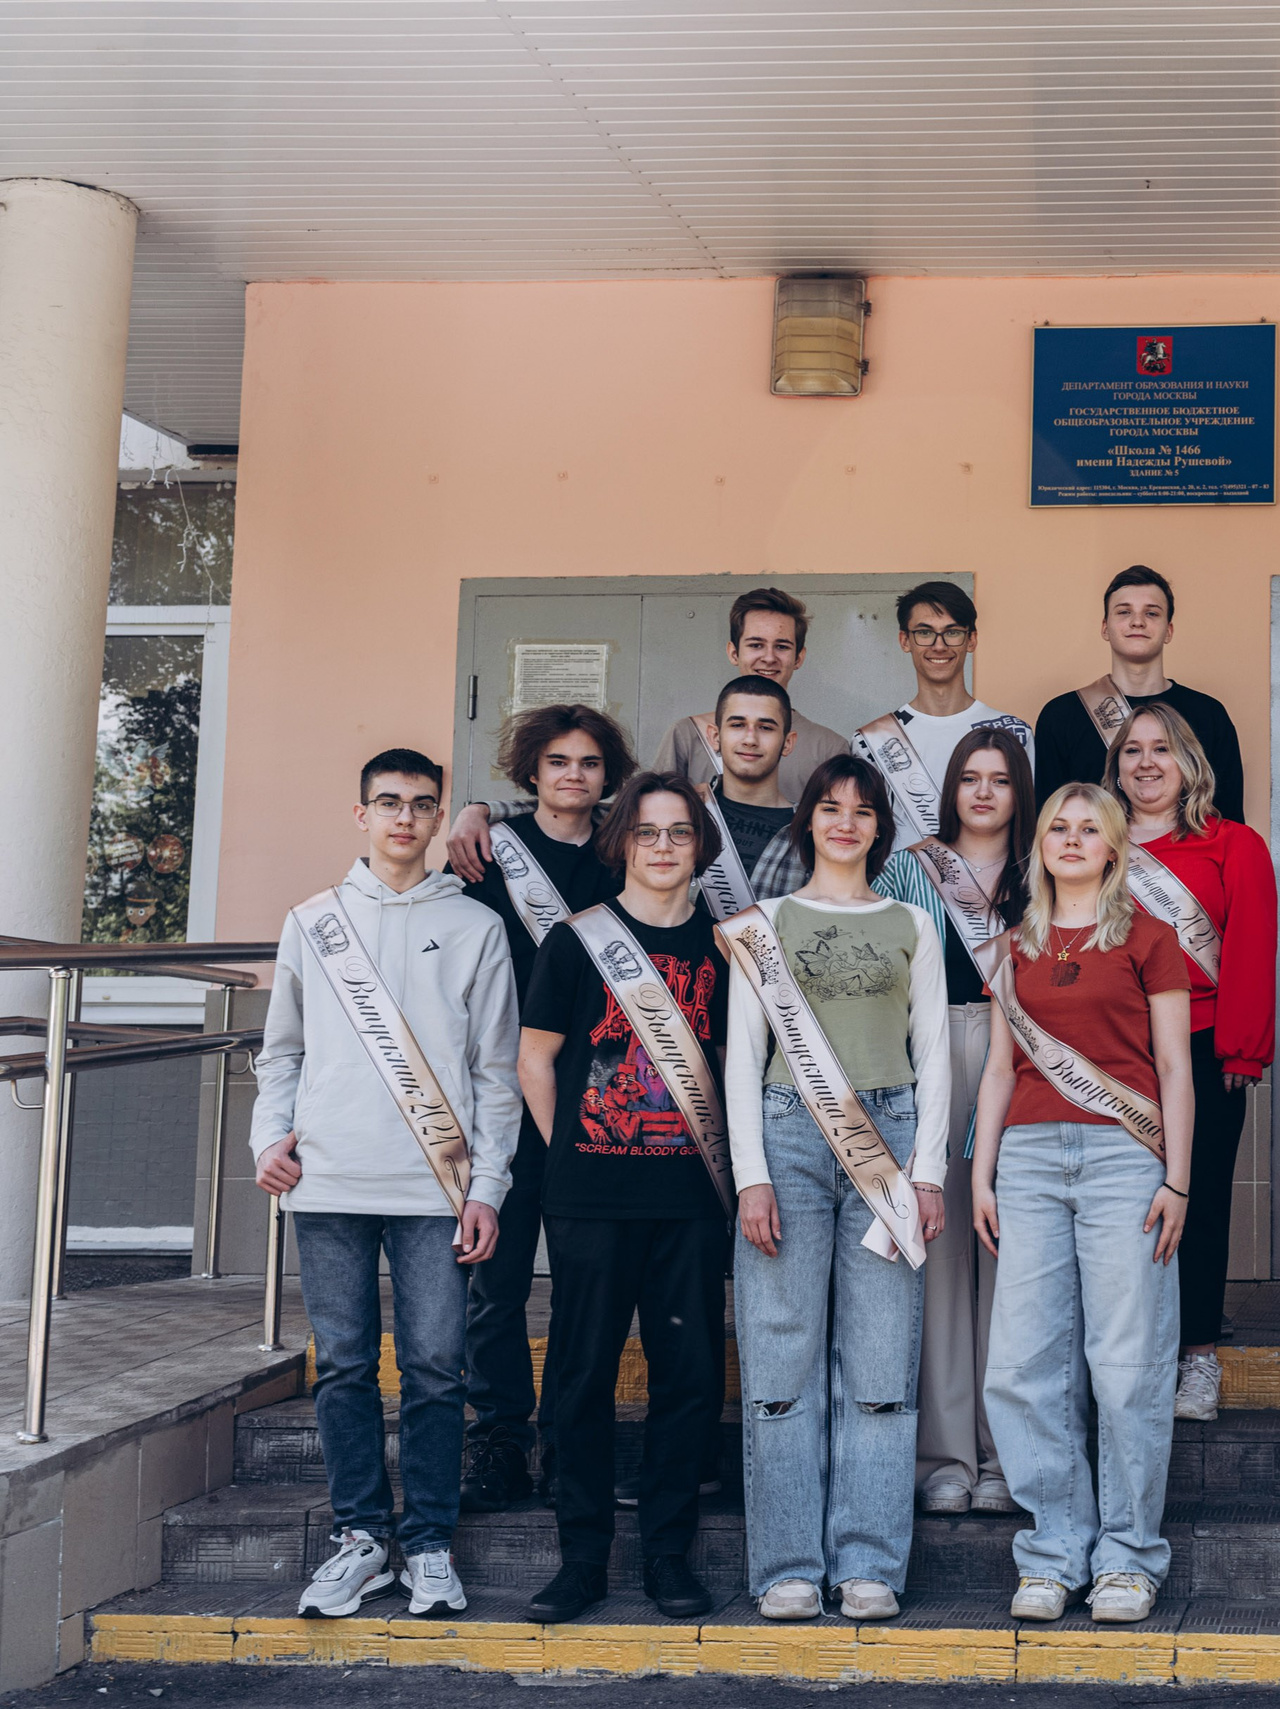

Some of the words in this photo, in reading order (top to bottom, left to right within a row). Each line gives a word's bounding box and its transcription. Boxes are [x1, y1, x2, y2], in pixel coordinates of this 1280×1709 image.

[1062, 382, 1133, 391] ДЕПАРТАМЕНТ
[1206, 381, 1213, 389] И
[1216, 381, 1249, 389] НАУКИ
[1113, 392, 1151, 401] ГОРОДА
[1154, 392, 1197, 400] МОСКВЫ
[1069, 407, 1169, 416] ГОСУДАРСТВЕННОЕ
[1172, 407, 1240, 415] БЮДЖЕТНОЕ
[1054, 418, 1182, 427] ОБЩЕОБРАЗОВАТЕЛЬНОЕ
[1185, 417, 1255, 426] УЧРЕЖДЕНИЕ
[1109, 428, 1149, 437] ГОРОДА
[1152, 428, 1198, 436] МОСКВЫ
[1107, 446, 1155, 455] «Школа
[1158, 446, 1172, 455] №
[1175, 445, 1200, 454] 1466
[1077, 458, 1113, 467] имени
[1116, 457, 1171, 468] Надежды
[1174, 456, 1232, 467] Рушевой»
[1173, 908, 1216, 952] 2024
[337, 956, 425, 1099] Выпускник
[409, 1098, 462, 1147] 2024
[631, 982, 714, 1126] Выпускник
[772, 982, 845, 1123] Выпускница
[832, 1119, 887, 1168] 2024
[1041, 1043, 1161, 1139] Выпускница
[630, 1146, 678, 1155] BLOODY
